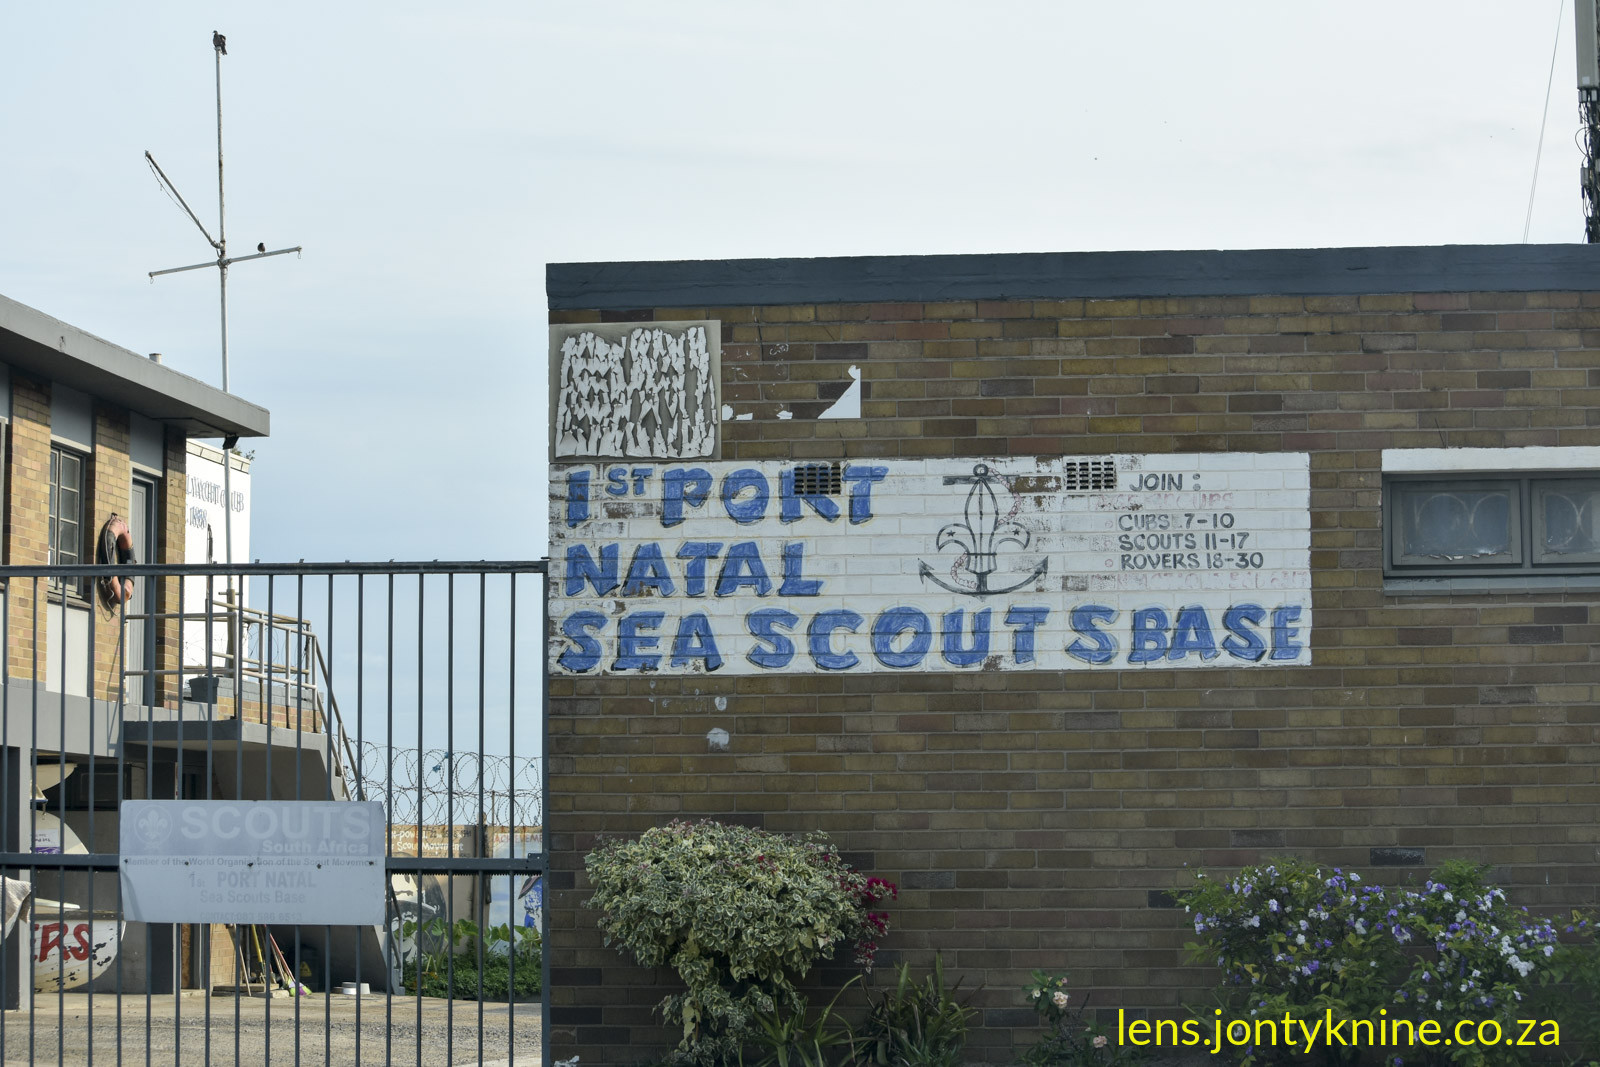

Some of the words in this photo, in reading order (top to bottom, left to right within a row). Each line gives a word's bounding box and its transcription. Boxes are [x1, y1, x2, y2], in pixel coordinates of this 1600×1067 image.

[1129, 473, 1183, 492] JOIN
[221, 490, 244, 510] CUB
[565, 465, 654, 528] 1ST
[661, 464, 889, 528] PORT
[1118, 514, 1169, 531] CUBS
[1184, 513, 1235, 529] 7-10
[1118, 532, 1197, 551] SCOUTS
[1205, 532, 1250, 550] 11-17
[564, 542, 824, 597] NATAL
[1121, 553, 1200, 570] ROVERS
[1206, 552, 1264, 569] 18-30
[557, 610, 724, 673] SEA
[744, 605, 1121, 670] SCOUTS
[1126, 603, 1303, 663] BASE
[179, 805, 371, 839] SCOUTS
[262, 840, 311, 854] South
[317, 839, 369, 855] Africa
[397, 842, 418, 851] Scou
[422, 842, 463, 851] Movemnt
[162, 858, 171, 866] of
[172, 858, 187, 866] the
[188, 858, 214, 866] World
[276, 858, 285, 866] of
[304, 858, 330, 866] Scout
[332, 858, 378, 867] Movemet
[217, 871, 260, 888] PORT
[265, 871, 317, 888] NATAL
[200, 889, 224, 903] Sea
[228, 889, 271, 904] Scouts
[275, 890, 306, 904] Base
